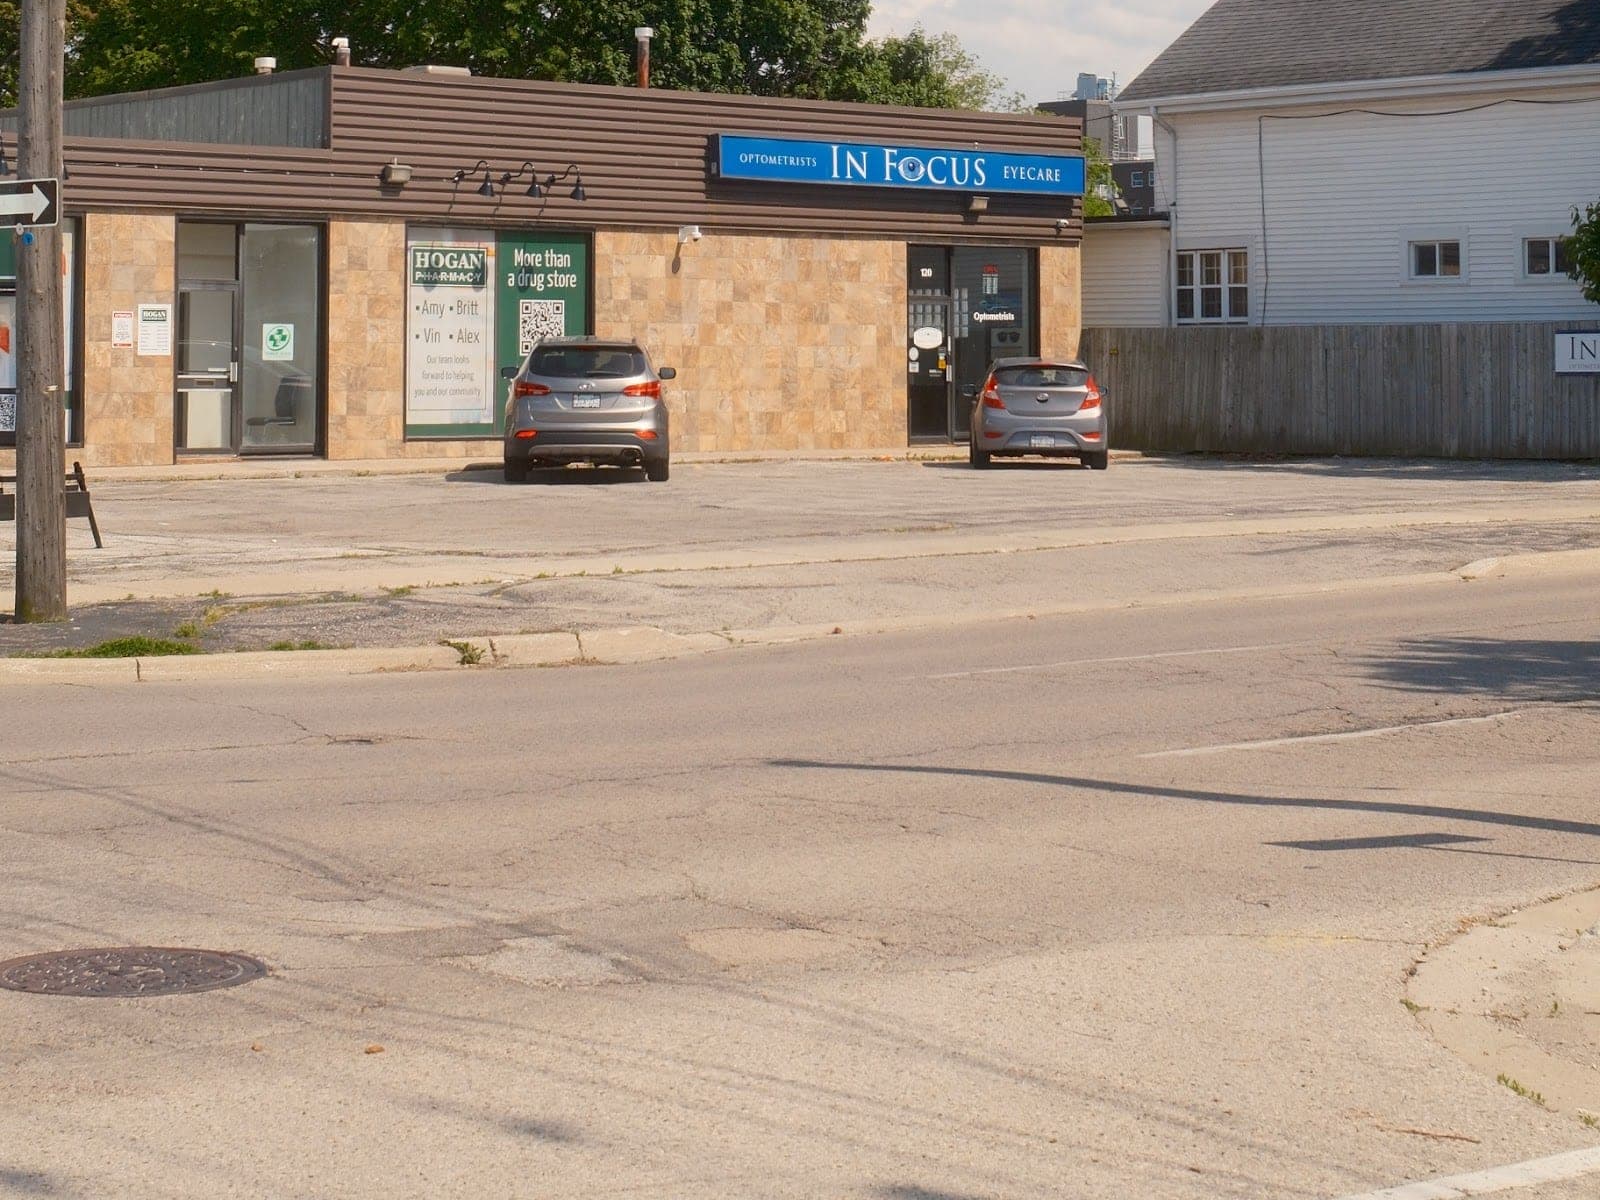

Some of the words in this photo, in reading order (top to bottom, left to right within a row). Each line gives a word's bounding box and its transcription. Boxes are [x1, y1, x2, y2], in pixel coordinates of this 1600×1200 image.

[739, 152, 817, 168] OPTOMETRISTS
[831, 145, 868, 180] IN
[1003, 165, 1061, 182] EYECARE
[415, 252, 483, 269] HOGAN
[514, 248, 542, 267] More
[545, 248, 571, 268] than
[507, 272, 515, 287] a
[517, 267, 545, 291] drug
[546, 269, 577, 288] store
[421, 300, 445, 319] Amy
[457, 300, 479, 316] Britt
[973, 311, 1015, 323] Optometrists
[424, 328, 441, 343] Vin
[457, 328, 480, 344] Alex
[1570, 336, 1597, 360] IN
